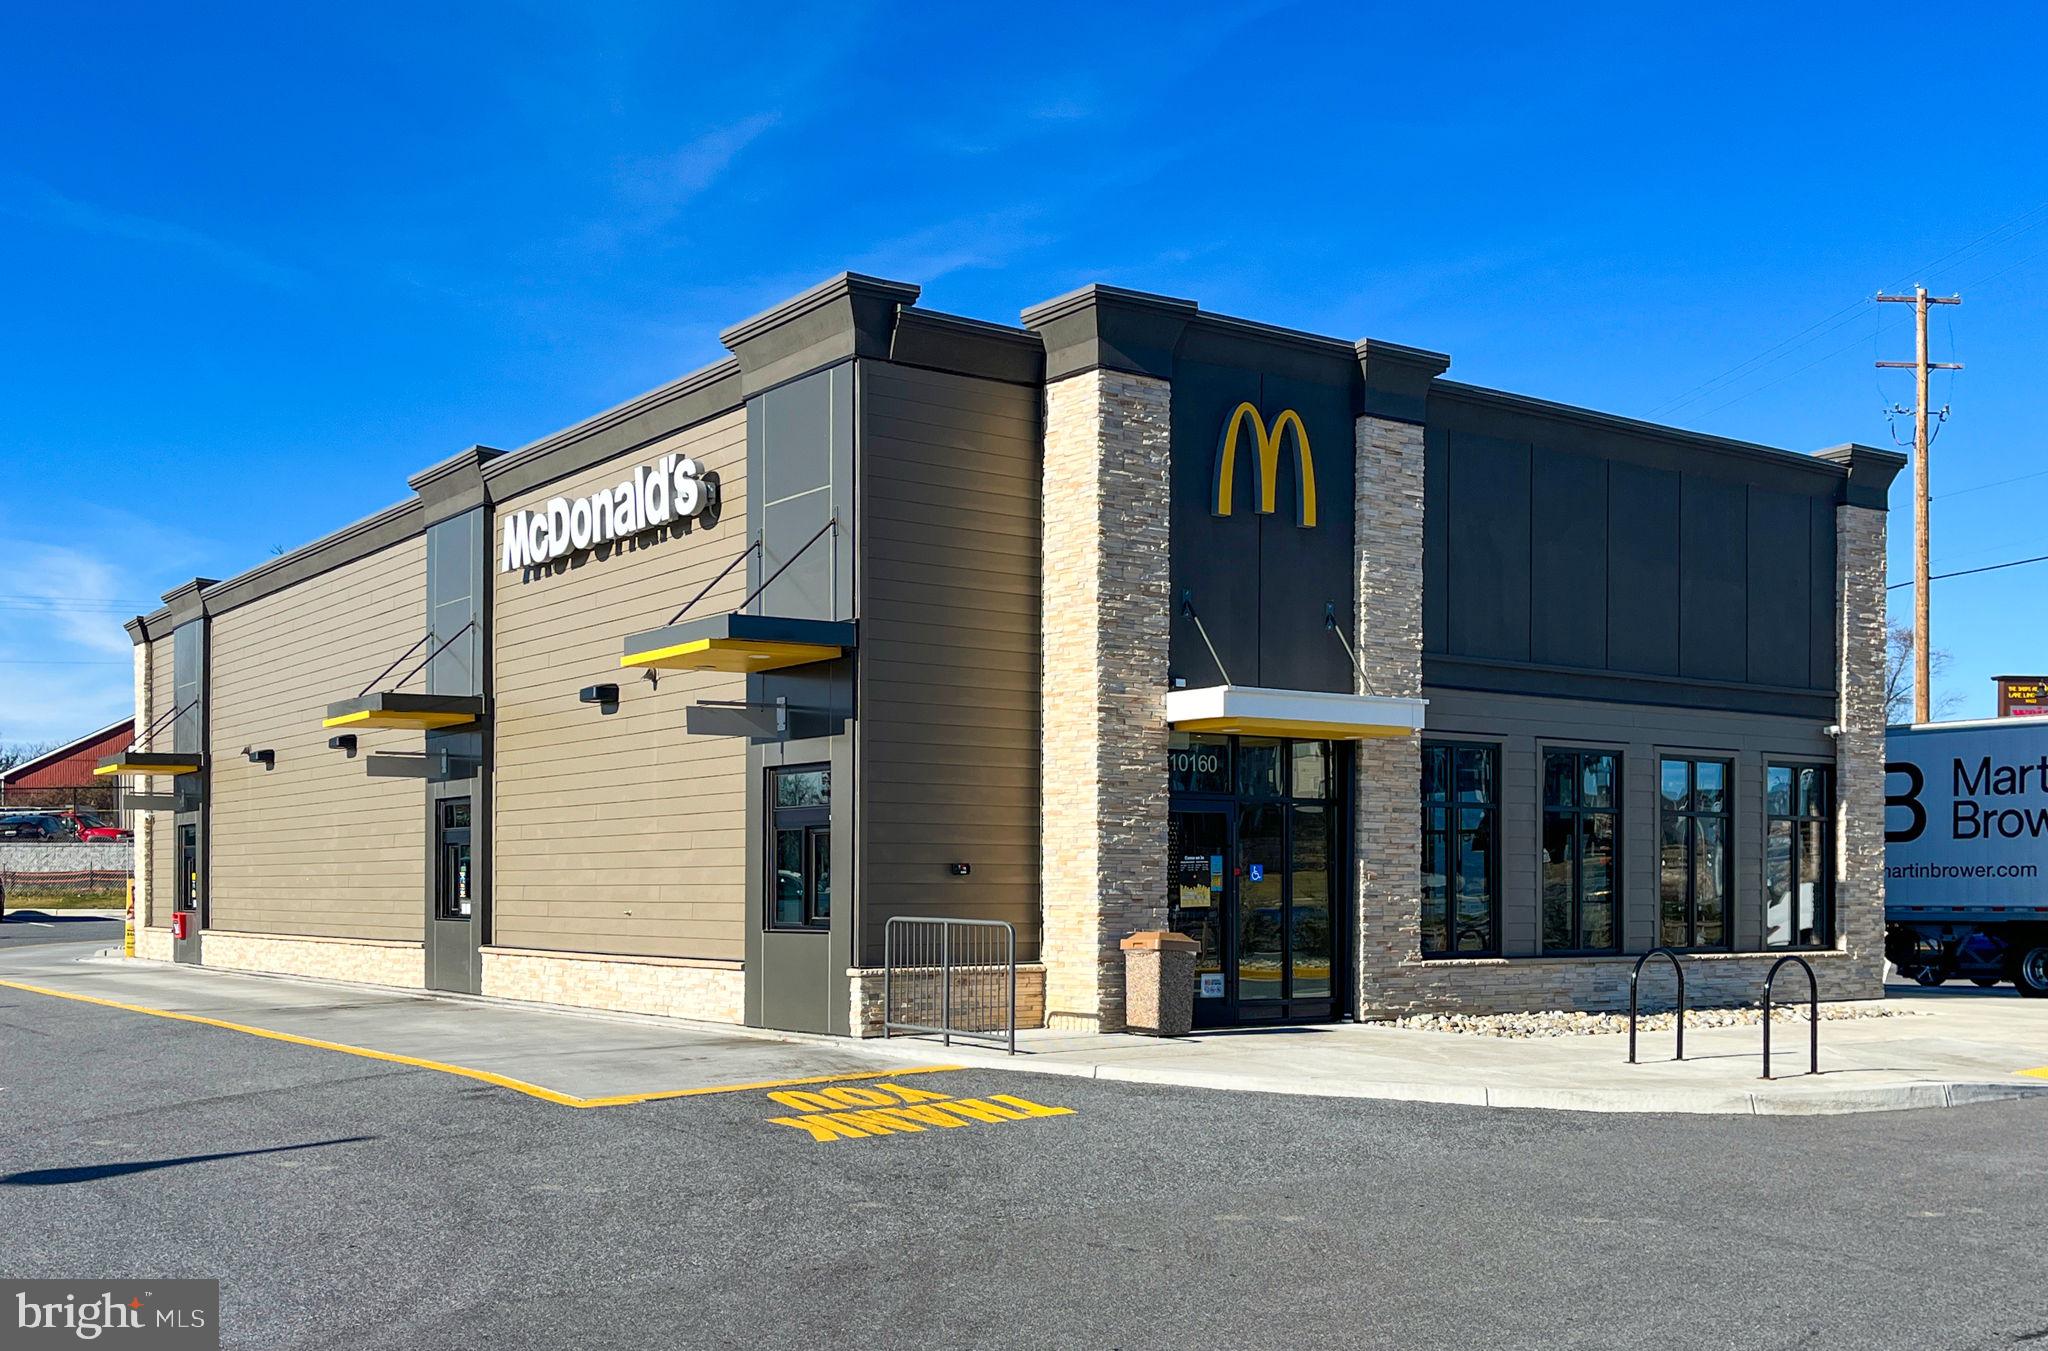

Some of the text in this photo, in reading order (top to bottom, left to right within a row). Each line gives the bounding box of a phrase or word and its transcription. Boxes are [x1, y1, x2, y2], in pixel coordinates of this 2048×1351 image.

[502, 453, 704, 573] McDonald's
[1170, 753, 1218, 773] 10160
[766, 1083, 954, 1112] YOU
[765, 1094, 1079, 1143] THANK
